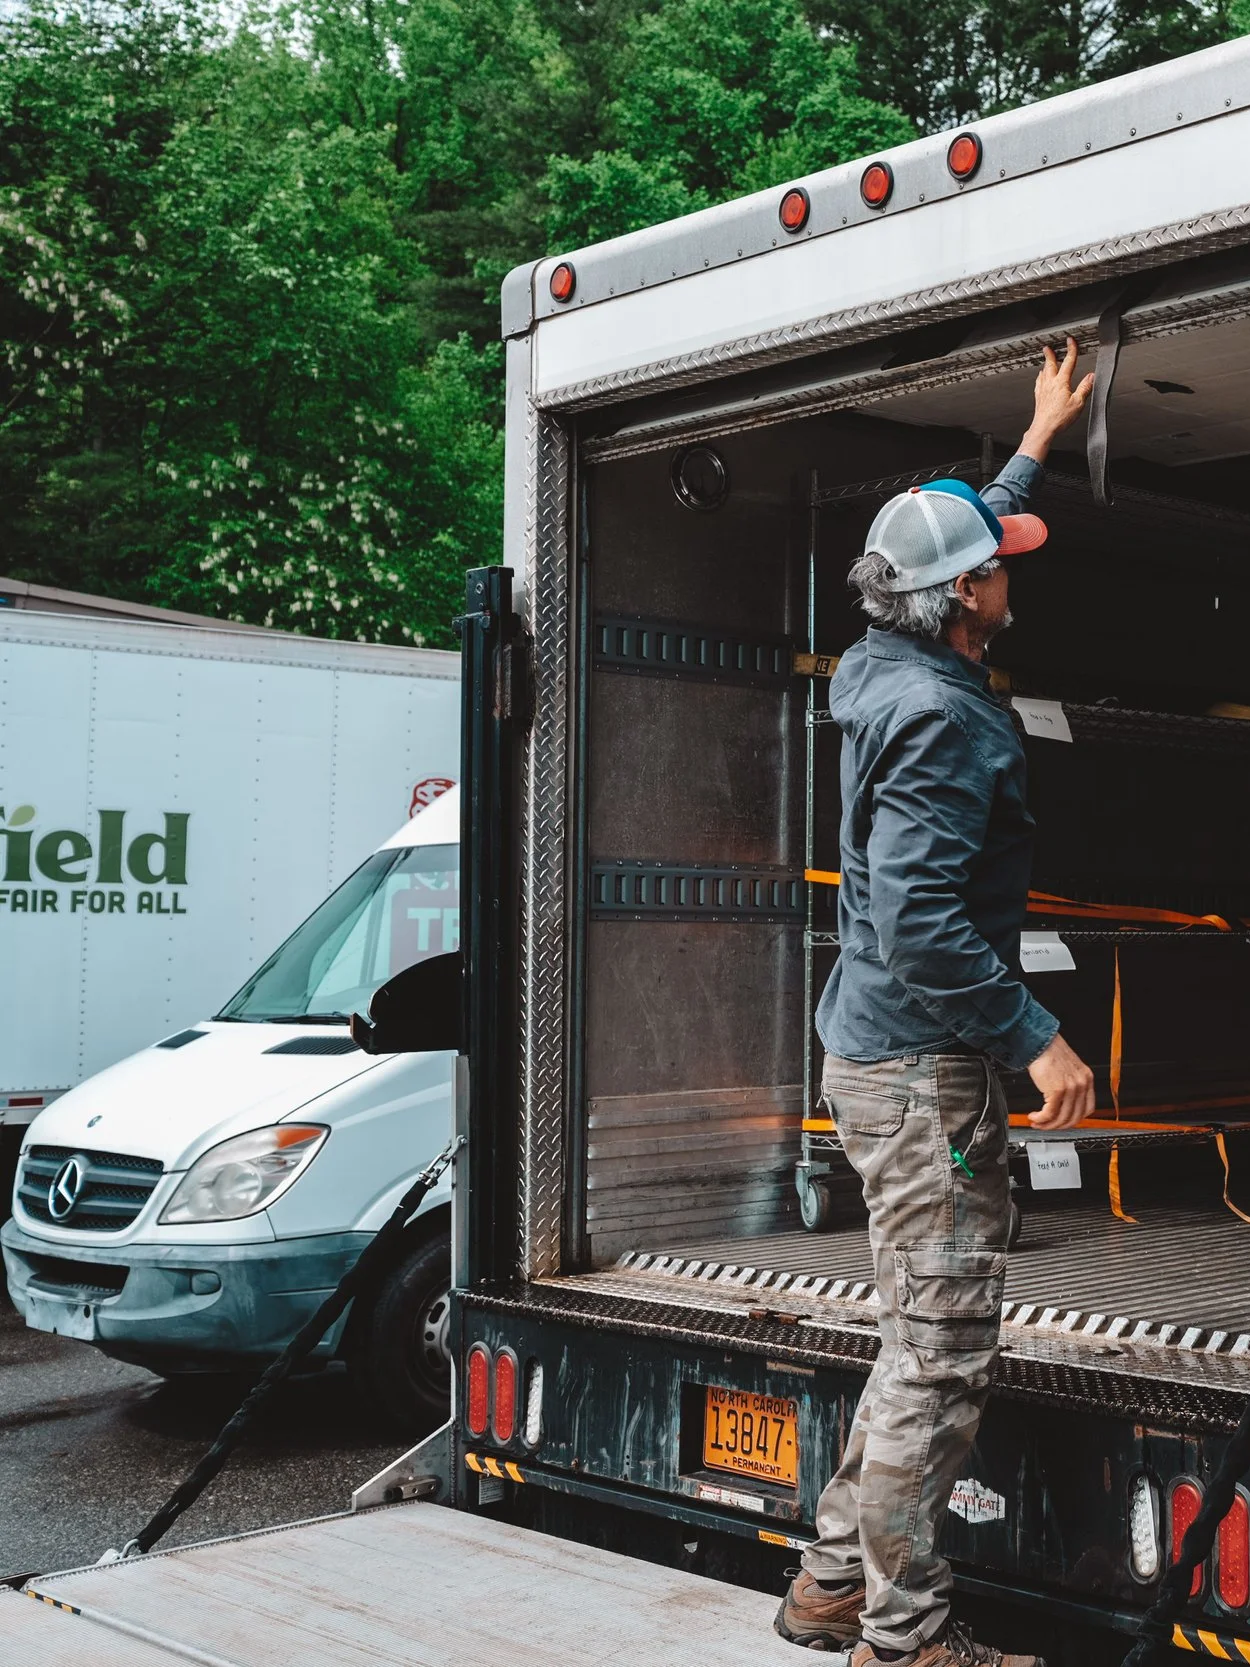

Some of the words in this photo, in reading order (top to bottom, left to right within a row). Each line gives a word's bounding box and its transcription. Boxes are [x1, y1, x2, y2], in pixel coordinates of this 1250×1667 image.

[0, 804, 190, 885] ield
[70, 890, 126, 914] FOR
[137, 891, 187, 914] ALL
[711, 1387, 748, 1410] NORTH
[732, 1456, 781, 1477] PERMANENT
